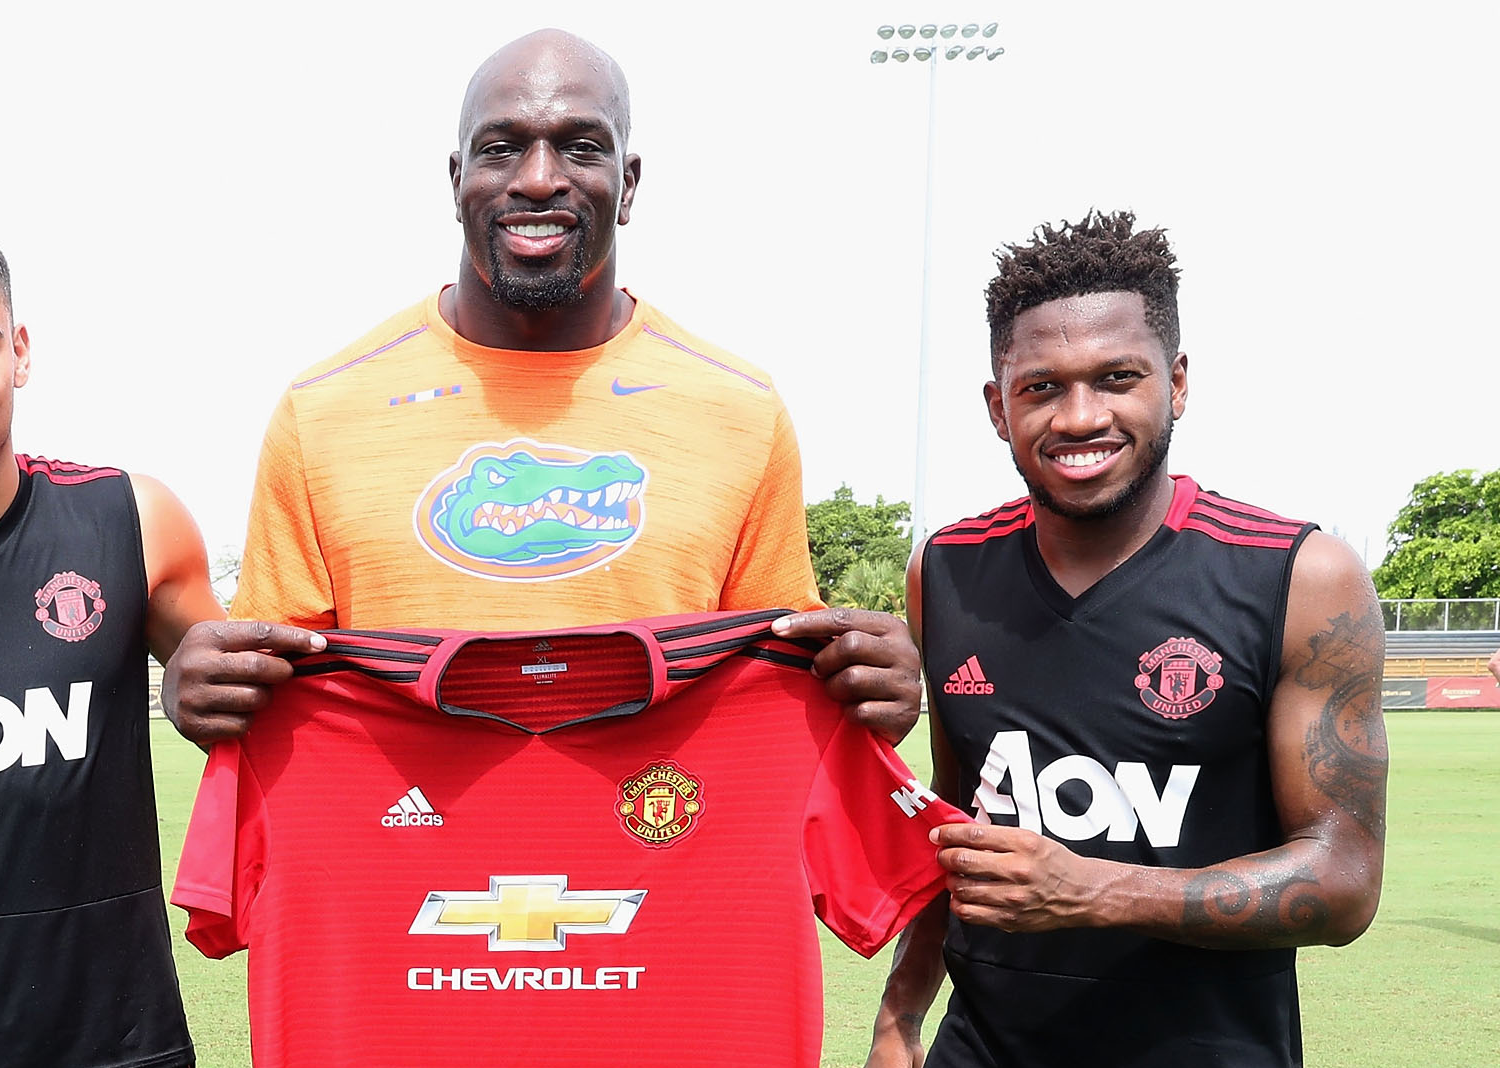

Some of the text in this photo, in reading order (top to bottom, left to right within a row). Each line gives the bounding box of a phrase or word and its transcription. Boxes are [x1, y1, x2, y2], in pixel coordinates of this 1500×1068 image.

[41, 577, 96, 604] MANCHESTER
[55, 622, 95, 637] UNITED
[536, 655, 551, 664] XL
[1145, 643, 1215, 670] MANCHESTER
[944, 679, 994, 695] adidas
[1152, 699, 1202, 714] UNITED
[629, 771, 692, 797] MANCHESTER
[381, 811, 444, 828] adidas
[636, 824, 681, 838] UNITED
[406, 966, 646, 991] CHEVROLET
